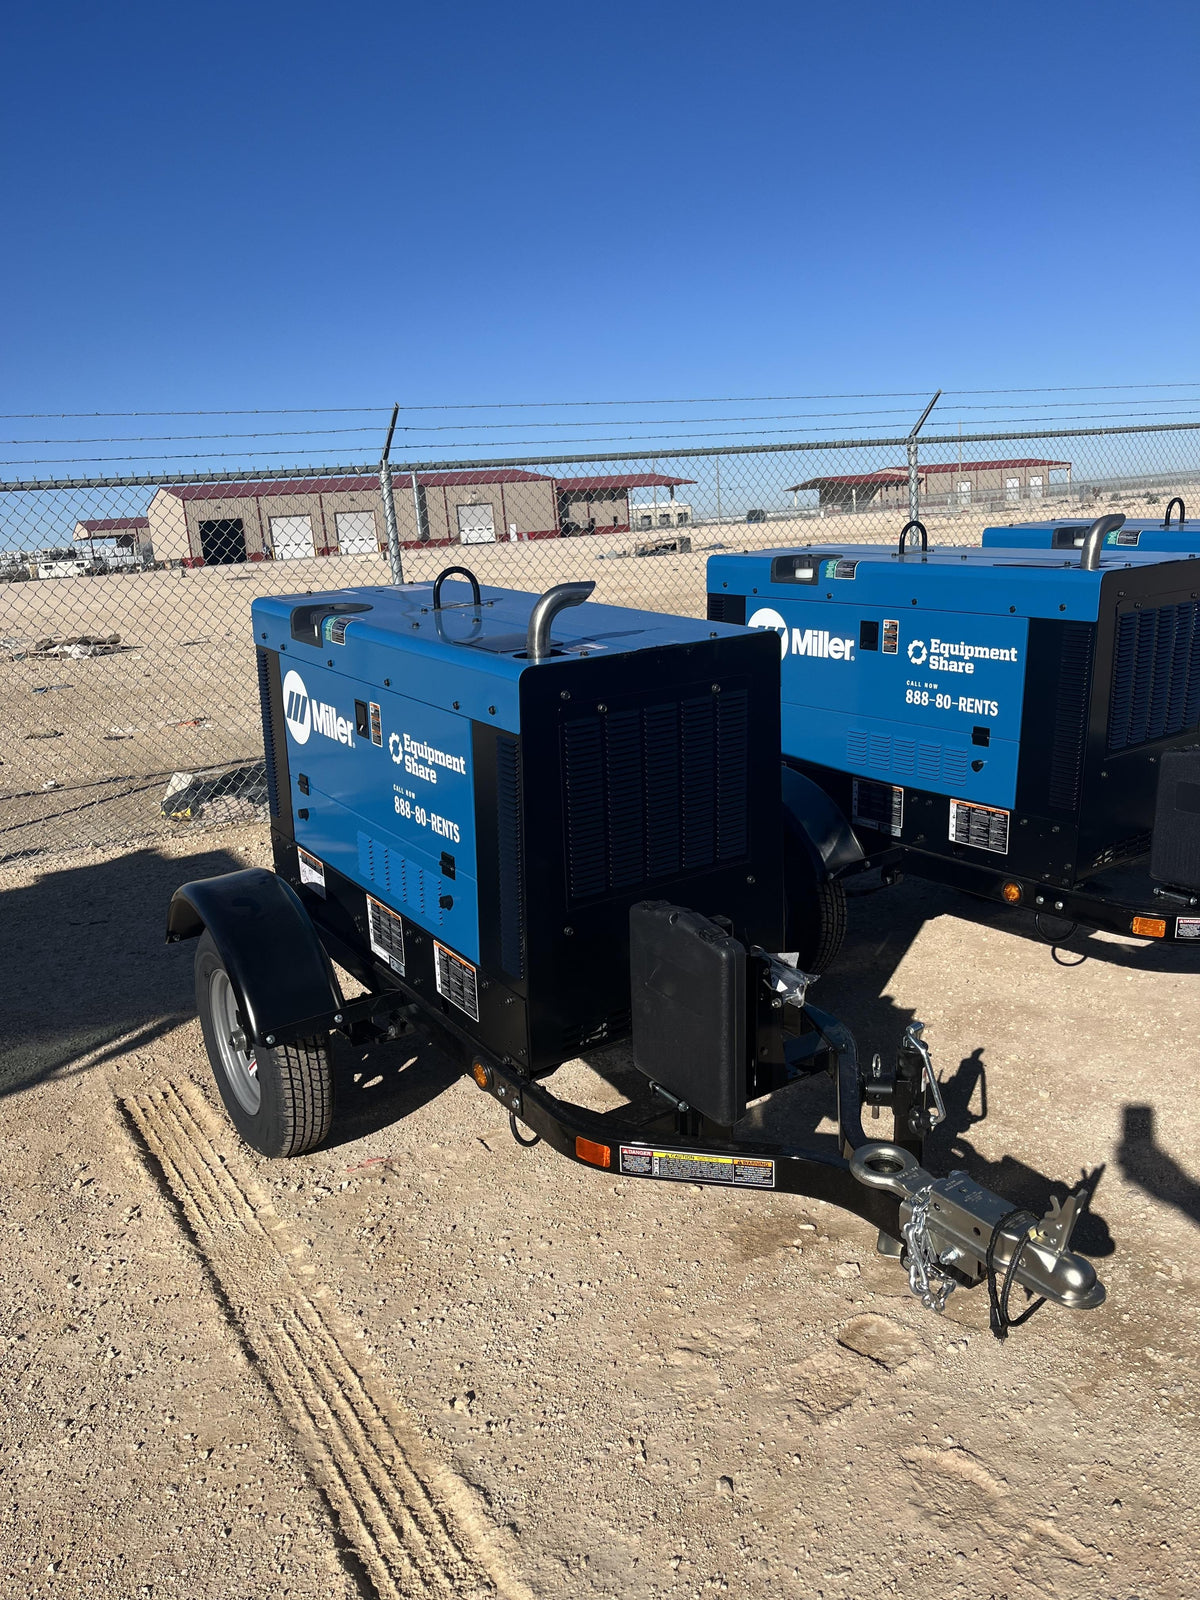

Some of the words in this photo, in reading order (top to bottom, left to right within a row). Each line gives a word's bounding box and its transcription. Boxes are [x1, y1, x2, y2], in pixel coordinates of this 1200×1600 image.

[792, 628, 854, 660] Miller
[929, 638, 1018, 662] Equipment
[929, 654, 975, 674] Share
[906, 679, 922, 687] CALL
[924, 682, 939, 690] NOW
[905, 688, 999, 717] 888-80-RENTS
[311, 699, 354, 748] Miller
[402, 732, 466, 776] Equipment
[404, 755, 437, 784] Share
[393, 783, 404, 795] CALL
[405, 789, 416, 800] NOW
[394, 795, 461, 844] 888-80-RENTS
[628, 1149, 652, 1157] DANGER
